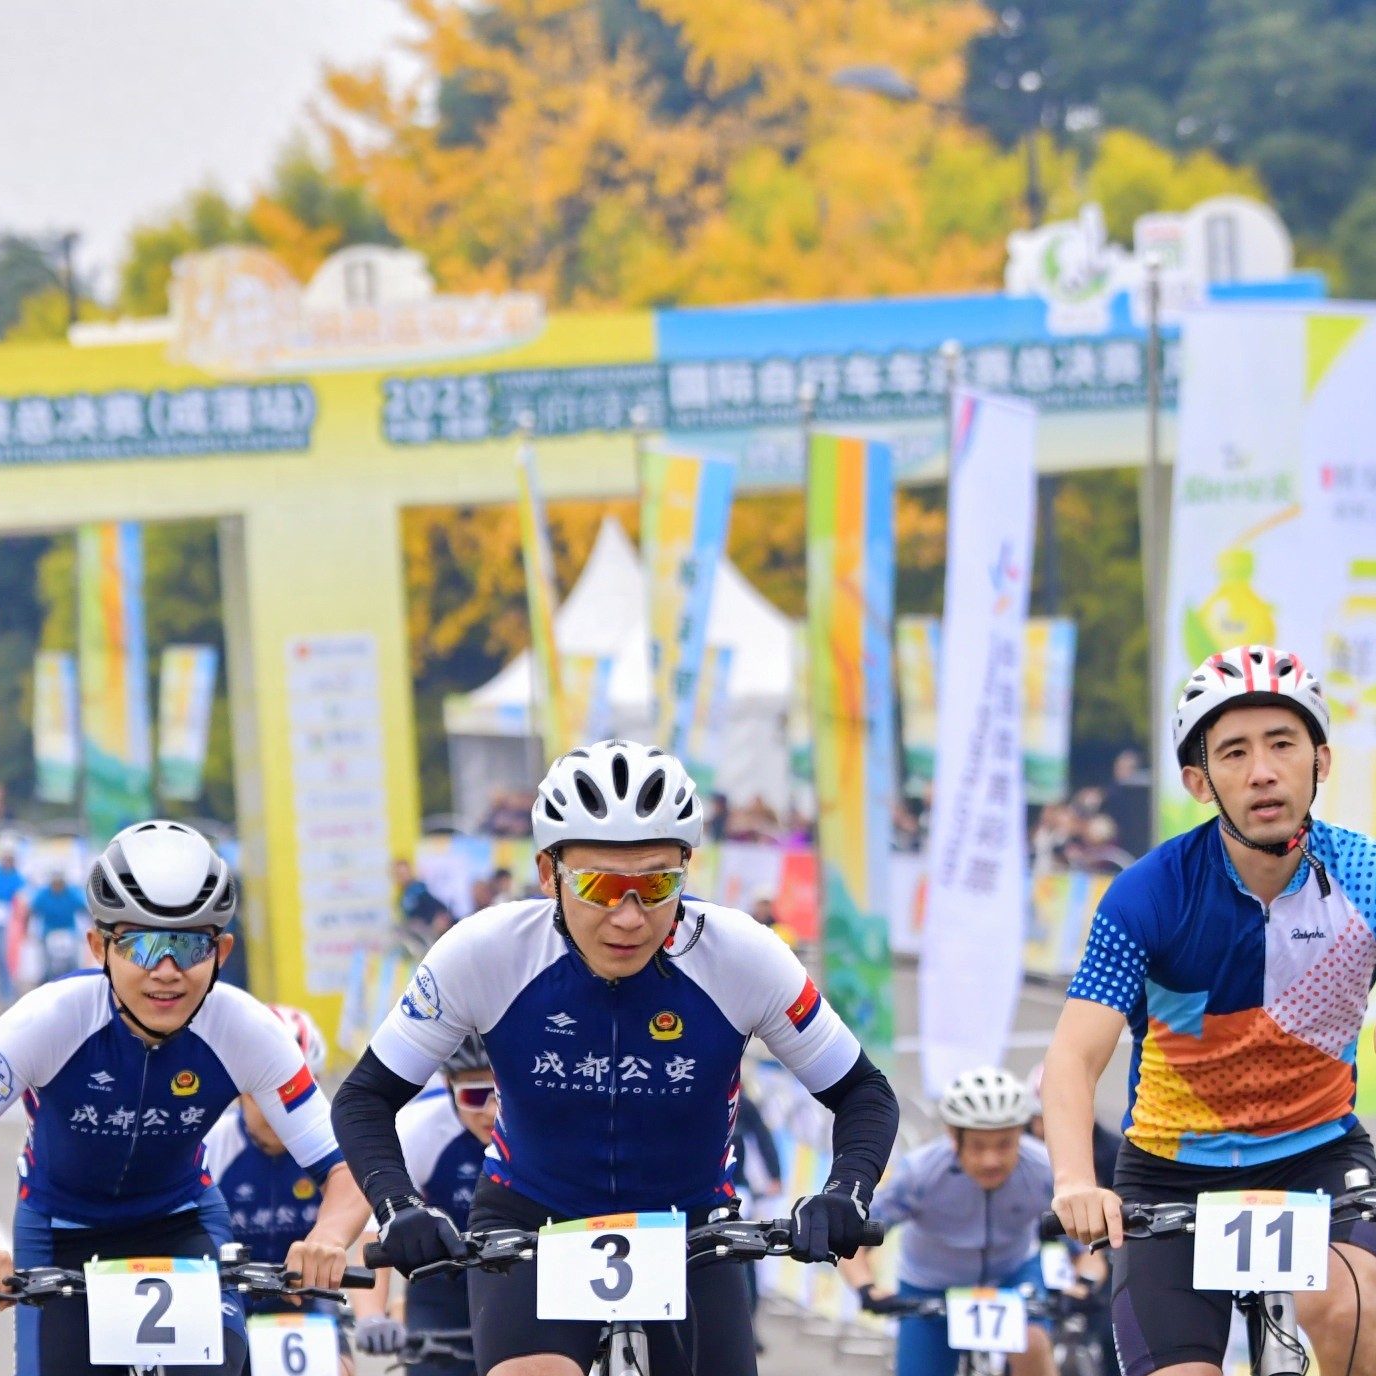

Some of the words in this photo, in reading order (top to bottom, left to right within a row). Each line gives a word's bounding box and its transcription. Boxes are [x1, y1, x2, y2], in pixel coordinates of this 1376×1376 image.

[384, 376, 490, 419] 2025
[544, 1026, 576, 1036] Santic
[530, 1050, 697, 1083] 成都公安
[70, 1103, 206, 1130] 成都公安
[1224, 1209, 1295, 1273] 11
[589, 1233, 634, 1301] 3
[1306, 1275, 1315, 1287] 2
[134, 1277, 176, 1344] 2
[663, 1303, 671, 1316] 1
[966, 1304, 1007, 1339] 17
[203, 1347, 210, 1360] 1
[281, 1332, 307, 1376] 6
